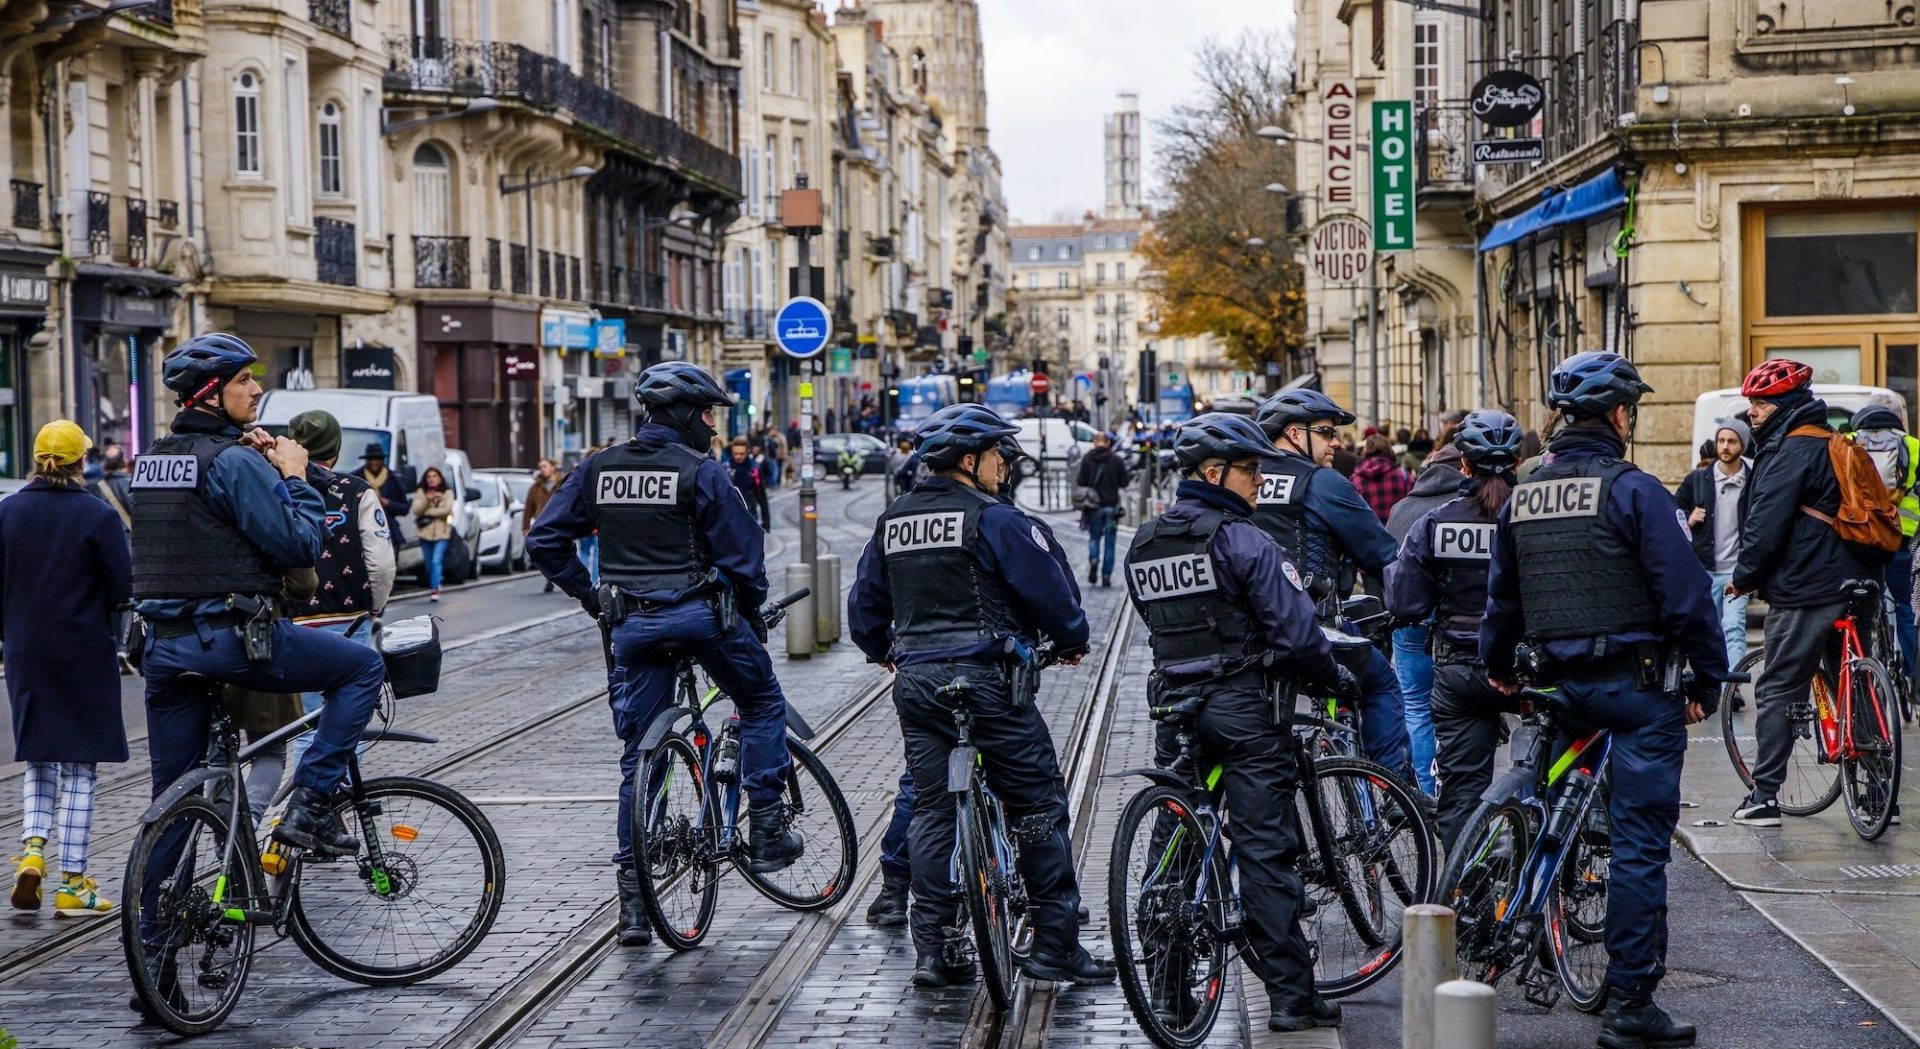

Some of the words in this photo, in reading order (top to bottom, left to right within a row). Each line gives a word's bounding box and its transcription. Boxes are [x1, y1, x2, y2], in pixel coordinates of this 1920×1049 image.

[1326, 83, 1353, 202] AGENCE
[1381, 108, 1405, 244] HOTEL
[1314, 221, 1367, 251] VICTOR
[1314, 252, 1367, 280] HUGO
[136, 460, 194, 482] POLICE
[601, 475, 672, 499] POLICE
[1515, 483, 1594, 516] POLICE
[888, 517, 957, 549] POLICE
[1441, 528, 1496, 554] POLI
[1135, 558, 1209, 595] POLICE
